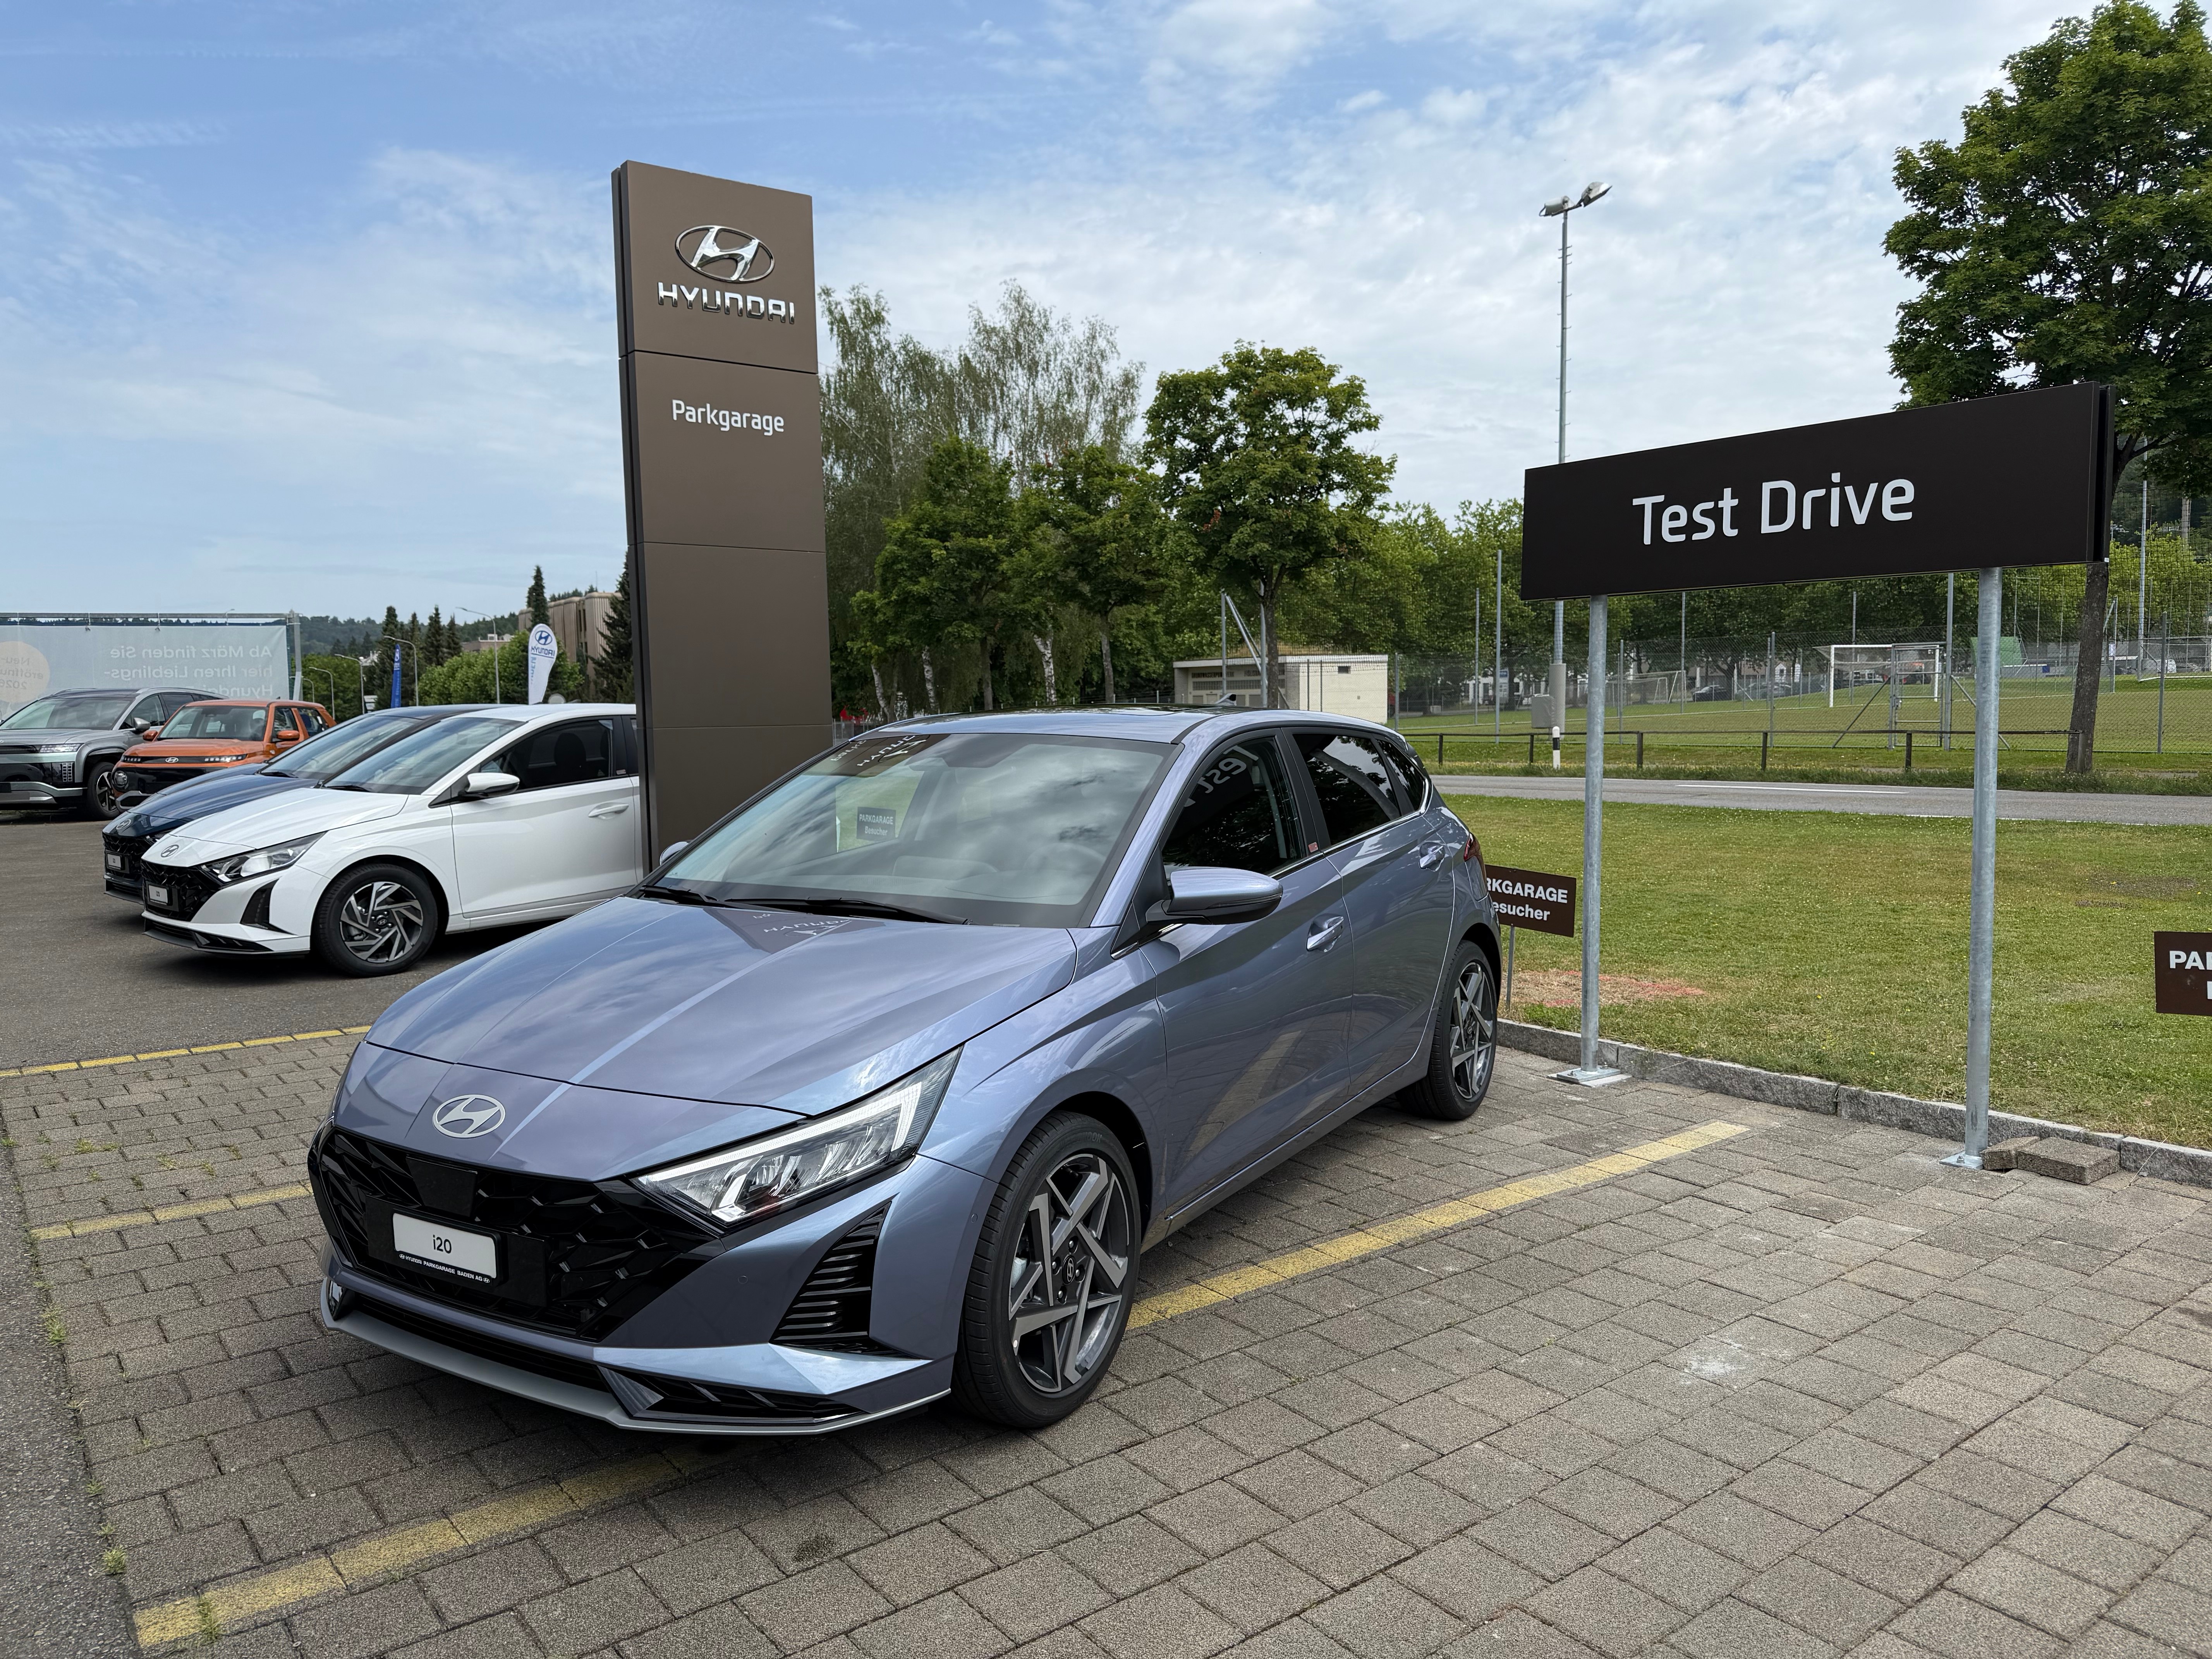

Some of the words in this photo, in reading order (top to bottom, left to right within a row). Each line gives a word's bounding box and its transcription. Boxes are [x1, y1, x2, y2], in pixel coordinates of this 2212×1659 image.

[657, 282, 795, 324] HYUNDAI
[672, 399, 784, 436] Parkgarage
[1632, 487, 1739, 545] Test
[1760, 472, 1915, 534] Drive
[531, 646, 555, 656] HYUNDAI
[859, 814, 893, 825] PARKGARAGE
[865, 826, 888, 836] Besucher
[433, 1234, 452, 1254] i20
[406, 1255, 422, 1264] HYUNDAI
[423, 1261, 455, 1274] PARKGARAGE
[457, 1270, 474, 1279] BADEN
